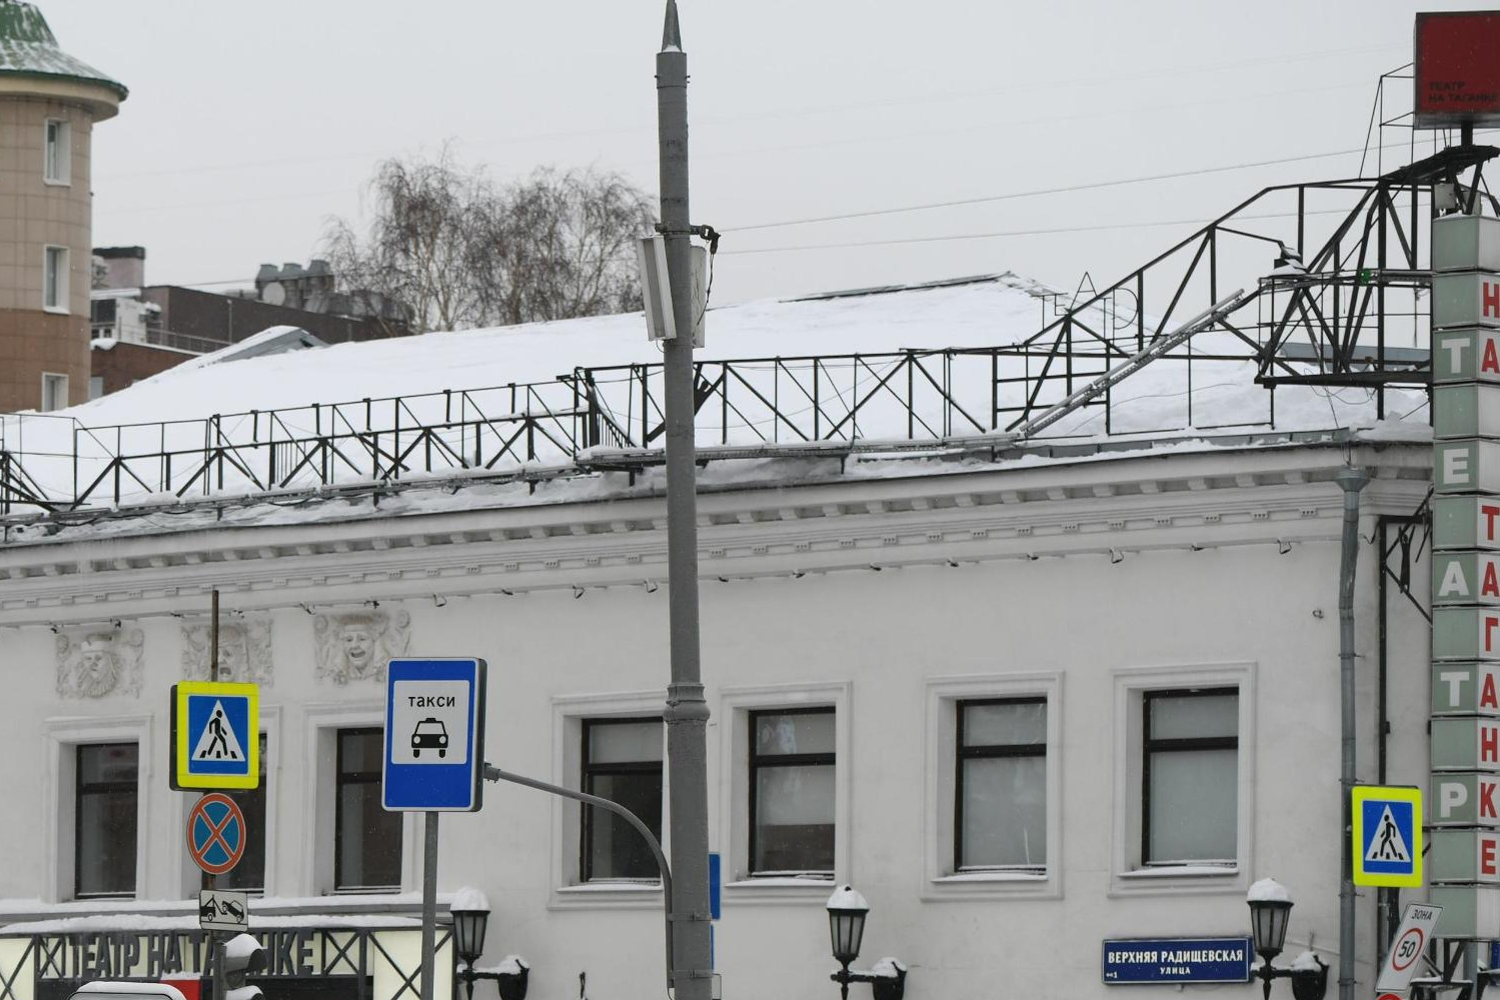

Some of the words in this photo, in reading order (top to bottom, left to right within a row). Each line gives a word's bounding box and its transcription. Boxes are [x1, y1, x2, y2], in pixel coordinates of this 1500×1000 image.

[1412, 909, 1433, 920] ЗОНА
[1398, 940, 1416, 958] 50
[1108, 951, 1158, 964] ВЕРХНЯЯ
[1161, 949, 1243, 964] РАДИЩЕВСКАЯ
[1160, 967, 1191, 976] УЛИЦА
